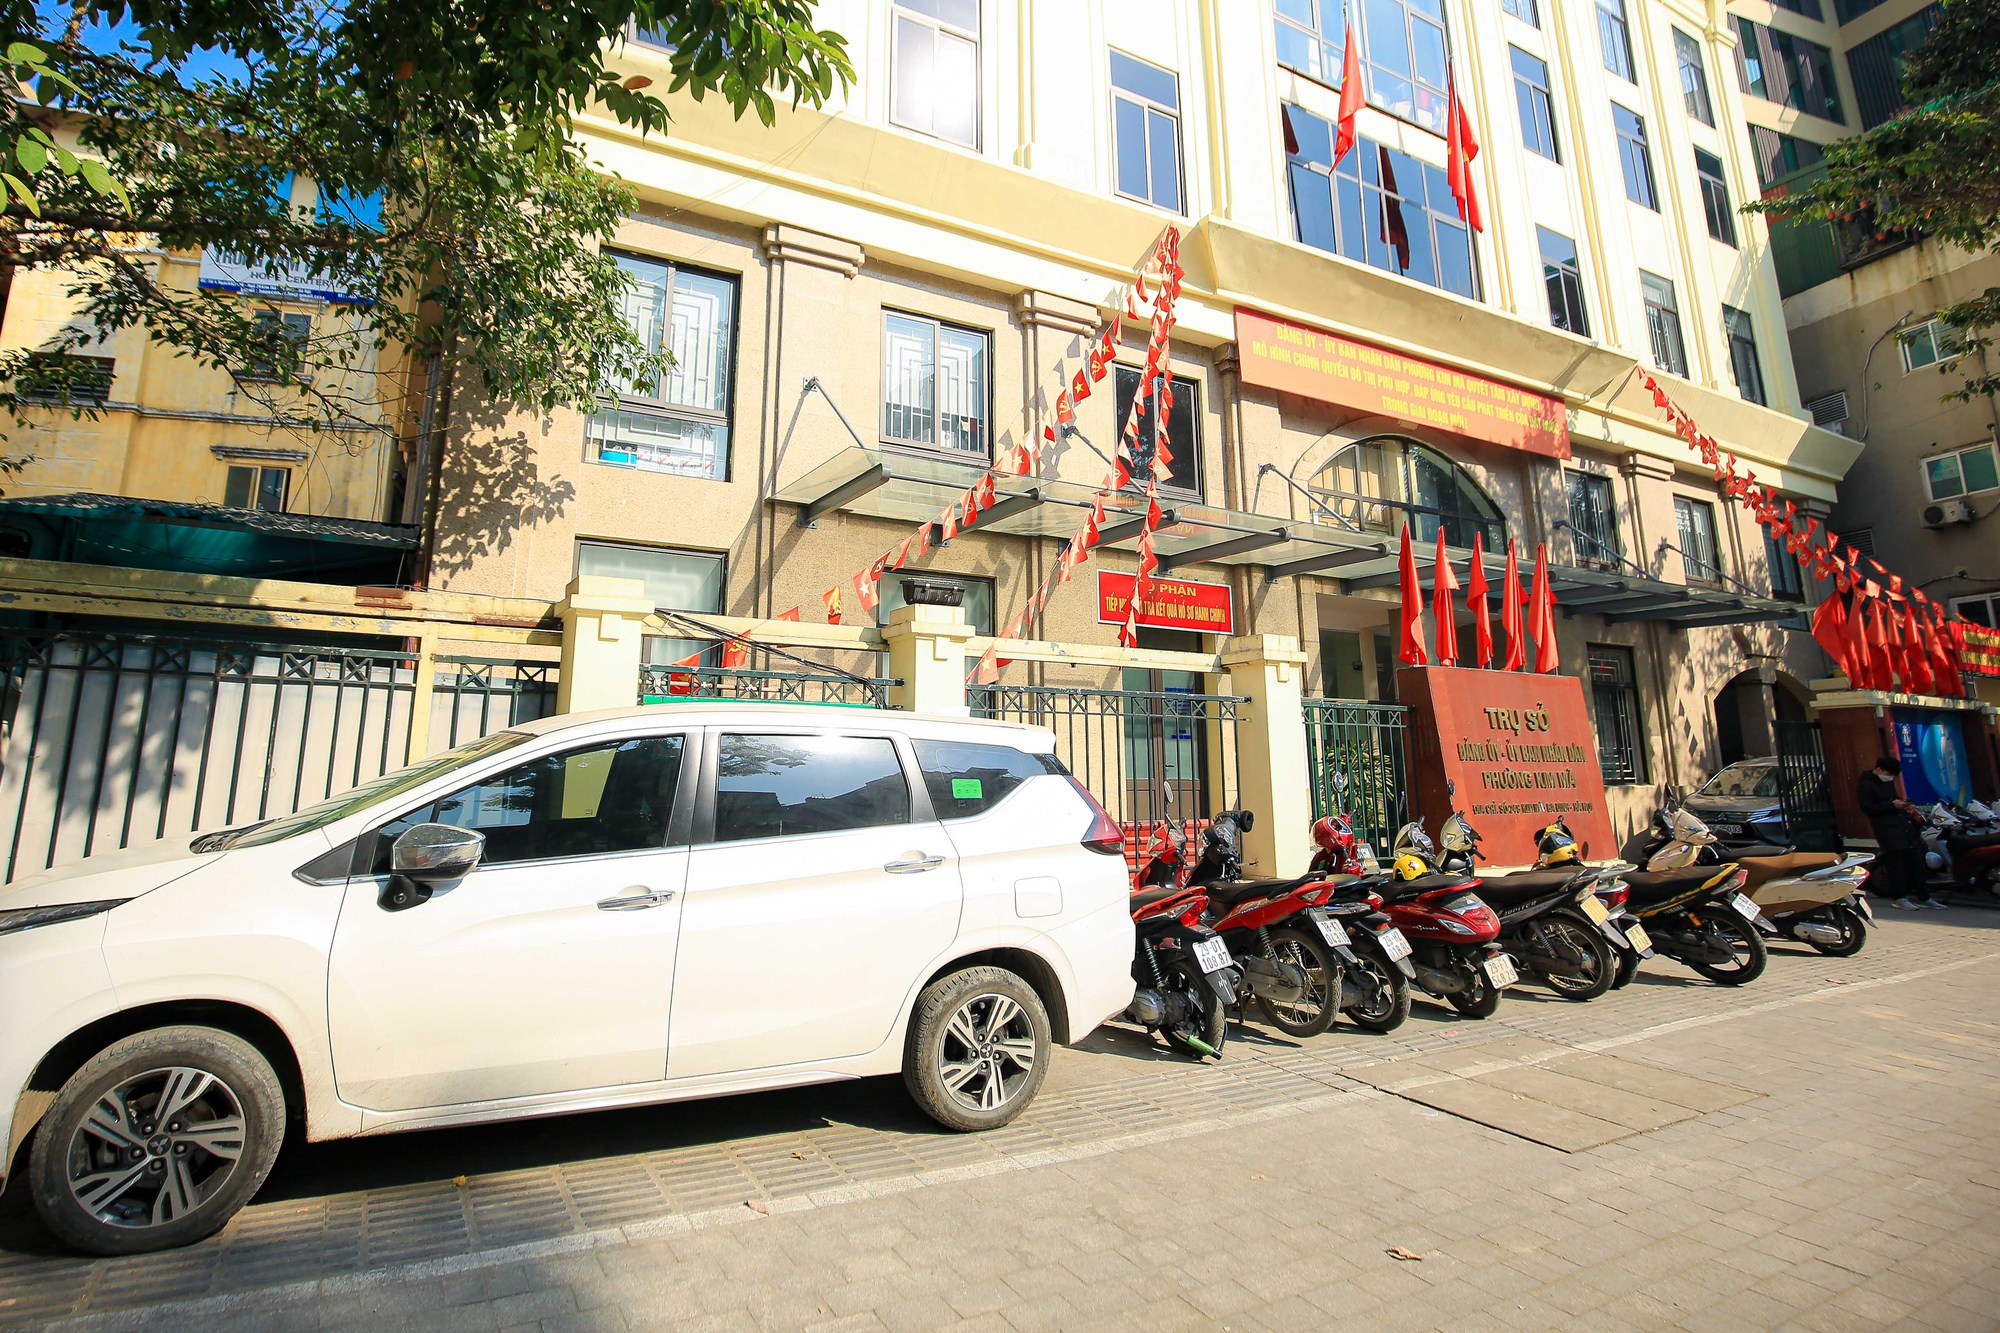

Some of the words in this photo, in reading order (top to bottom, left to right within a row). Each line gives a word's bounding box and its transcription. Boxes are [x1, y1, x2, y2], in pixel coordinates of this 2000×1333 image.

[250, 271, 282, 281] HOPE
[286, 275, 330, 287] CENTER
[1276, 322, 1303, 345] ĐẢNG
[1304, 328, 1316, 349] ỦY
[1324, 334, 1336, 354] ỦY
[1338, 342, 1357, 360] BAN
[1359, 349, 1382, 367] NHÂN
[1383, 355, 1401, 373] DÂN
[1402, 361, 1435, 381] PHƯỜNG
[1436, 370, 1452, 386] KIM
[1466, 379, 1489, 396] QUYẾT
[1489, 384, 1506, 401] TÂM
[1507, 389, 1521, 405] XÂY
[1252, 340, 1267, 358] MÔ
[1269, 344, 1291, 364] HÌNH
[1293, 351, 1320, 371] CHÍNH
[1350, 366, 1361, 382] ĐÔ
[1363, 369, 1376, 388] THỊ
[1413, 383, 1429, 399] ĐÁP
[1430, 384, 1446, 404] ỨNG
[1477, 401, 1494, 417] PHÁT
[1381, 395, 1409, 415] TRONG
[1410, 403, 1426, 419] GIAI
[1160, 584, 1196, 598] PHẬN
[1105, 592, 1118, 612] TIẾP
[1155, 597, 1165, 616] KẾT
[1166, 598, 1177, 619] QUẢ
[1195, 602, 1209, 621] HÀNH
[1484, 707, 1521, 736] TRỤ
[1525, 702, 1551, 732] SỞ
[1457, 737, 1485, 761] ĐẢNG
[1486, 738, 1500, 762] ỦY
[1506, 738, 1520, 762] ỦY
[1520, 744, 1540, 762] BAN
[1540, 742, 1567, 762] NHÂN
[1567, 743, 1586, 762] DÂN
[1482, 768, 1533, 789] PHƯỜNG
[1534, 771, 1556, 788] KIM
[1556, 768, 1576, 788] MÃ
